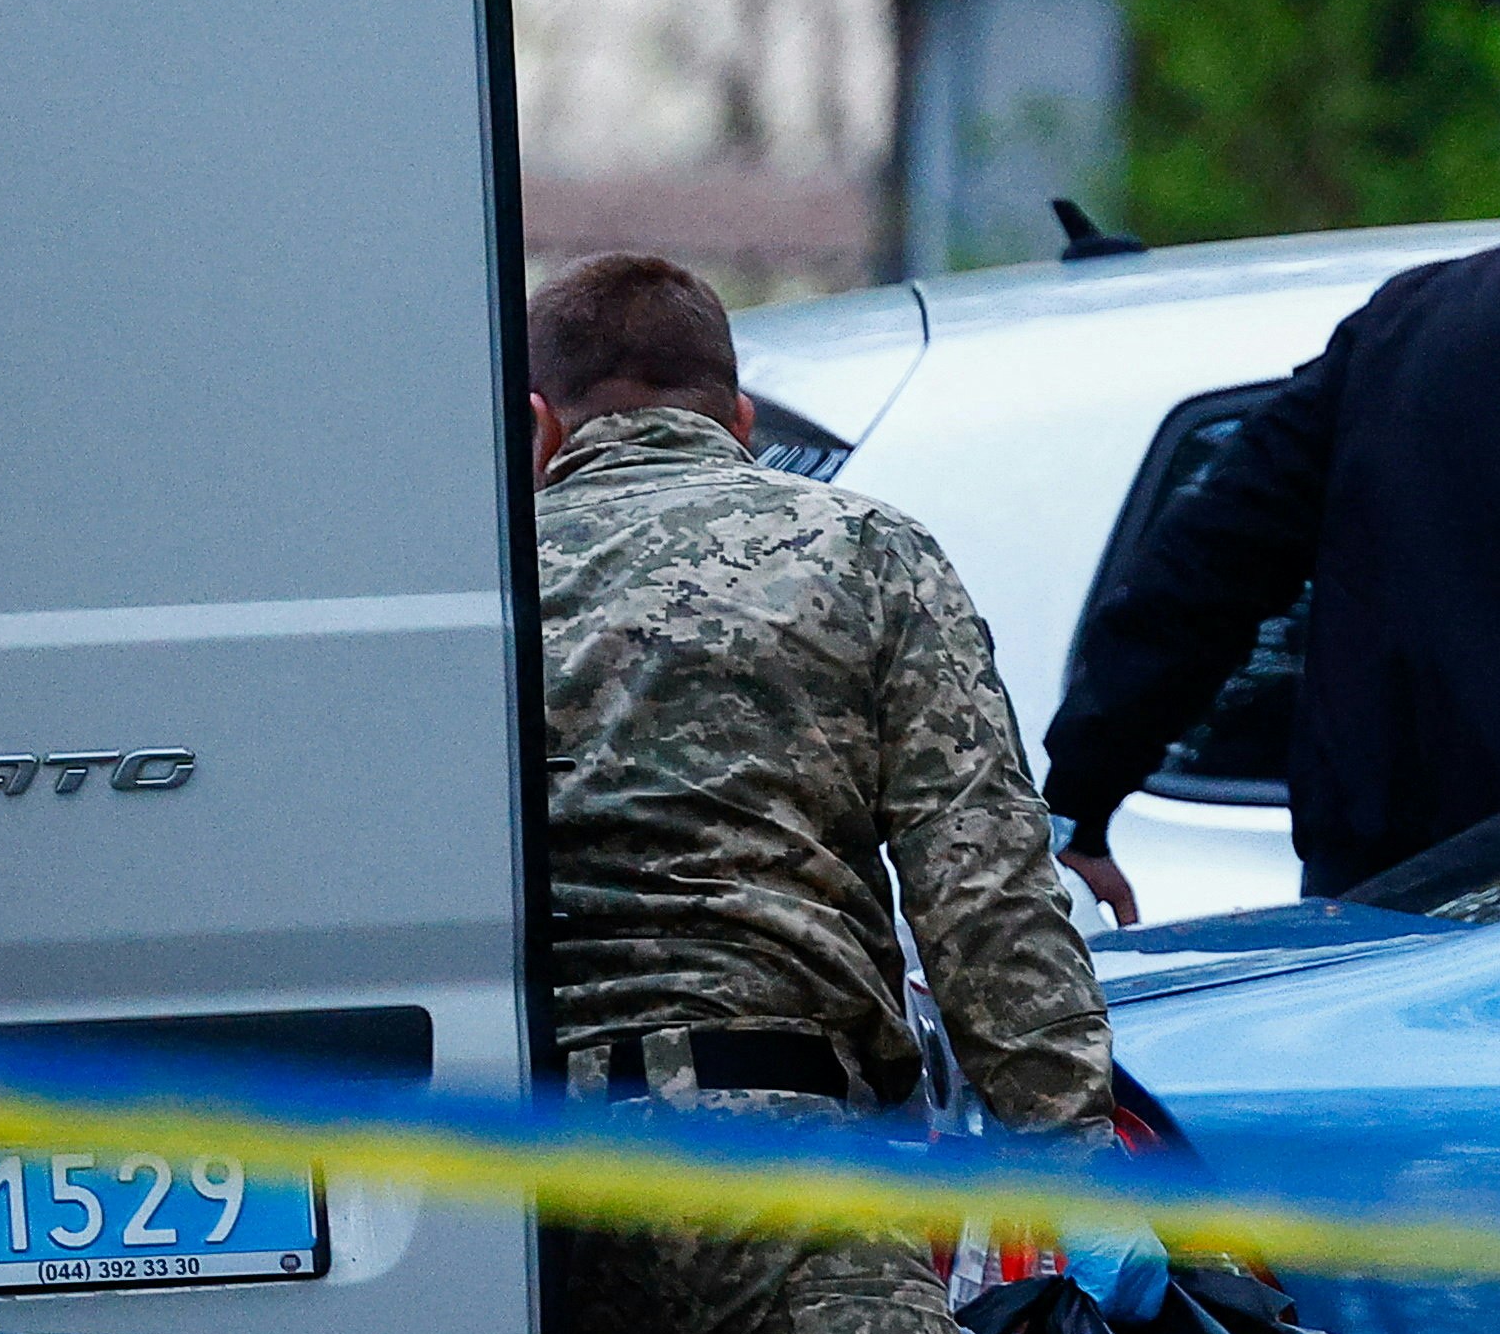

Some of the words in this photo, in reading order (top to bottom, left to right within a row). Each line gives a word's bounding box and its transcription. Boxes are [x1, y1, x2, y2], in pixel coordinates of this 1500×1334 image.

[38, 1261, 91, 1283] (044)
[99, 1261, 136, 1278] 392
[143, 1259, 168, 1276] 33
[175, 1257, 200, 1275] 30
